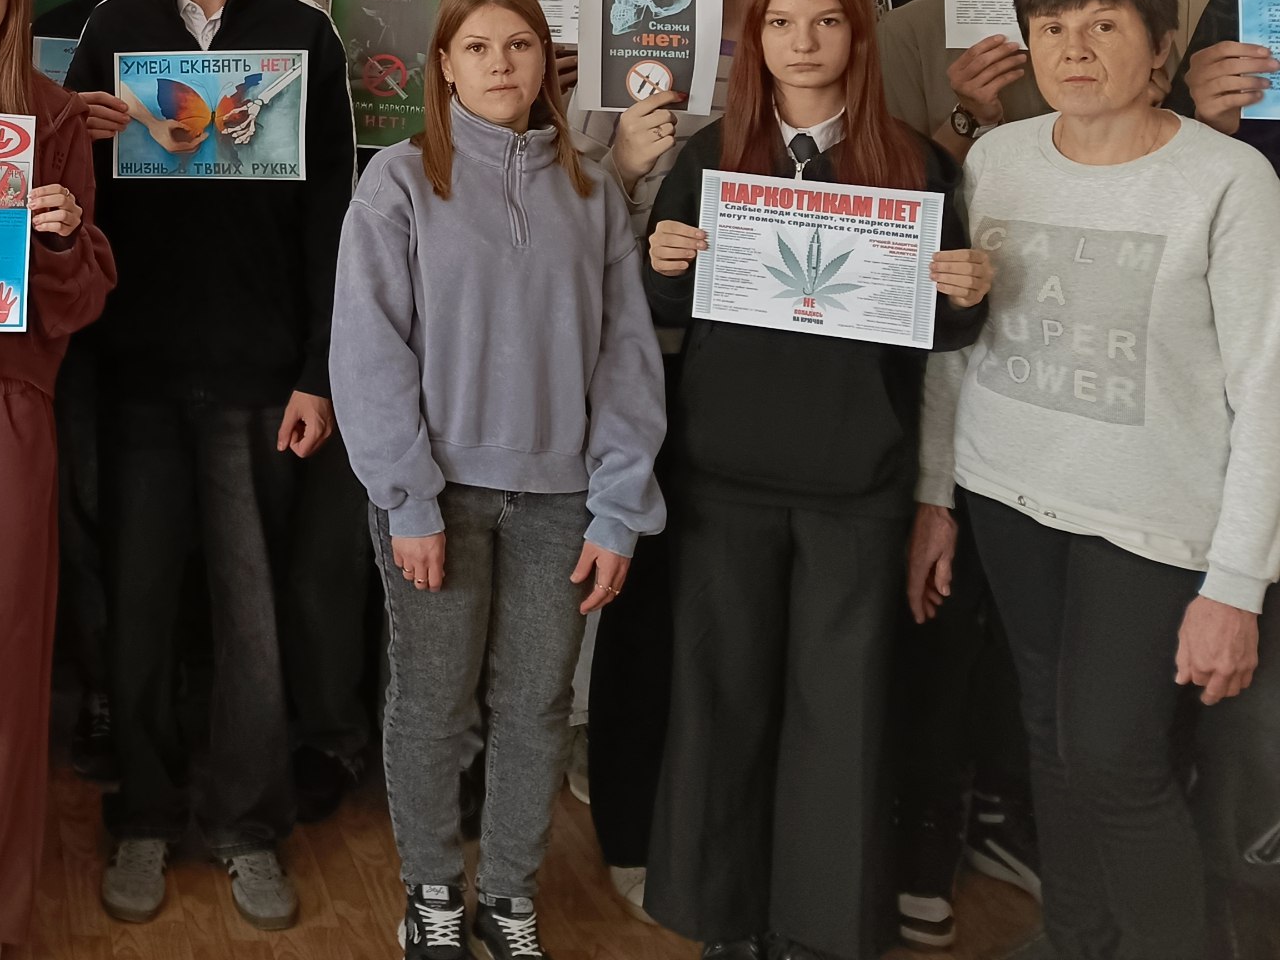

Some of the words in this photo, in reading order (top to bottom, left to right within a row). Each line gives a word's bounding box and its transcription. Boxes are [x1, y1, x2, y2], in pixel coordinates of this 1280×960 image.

[648, 21, 690, 32] Скажи
[609, 48, 690, 59] наркотикам!
[122, 58, 171, 75] УМЕЙ
[180, 59, 252, 74] СКАЗАТЬ
[379, 103, 426, 115] НАРКОТИКА
[365, 114, 406, 130] НЕТ!
[120, 162, 169, 174] ЖИЗНЬ
[193, 162, 242, 175] ТВОИХ
[251, 163, 300, 177] РУКАХ
[720, 181, 873, 218] НАРКОТИКАМ
[878, 197, 921, 223] НЕТ
[724, 203, 762, 213] Слабые
[763, 208, 791, 217] люди
[792, 212, 837, 222] считают,
[858, 219, 915, 230] наркотики
[719, 212, 747, 221] могут
[749, 216, 786, 225] помочь
[787, 220, 845, 231] справиться
[853, 227, 919, 239] проблемами
[1036, 275, 1066, 306] A
[803, 297, 815, 308] НЕ
[1001, 312, 1137, 362] UPER
